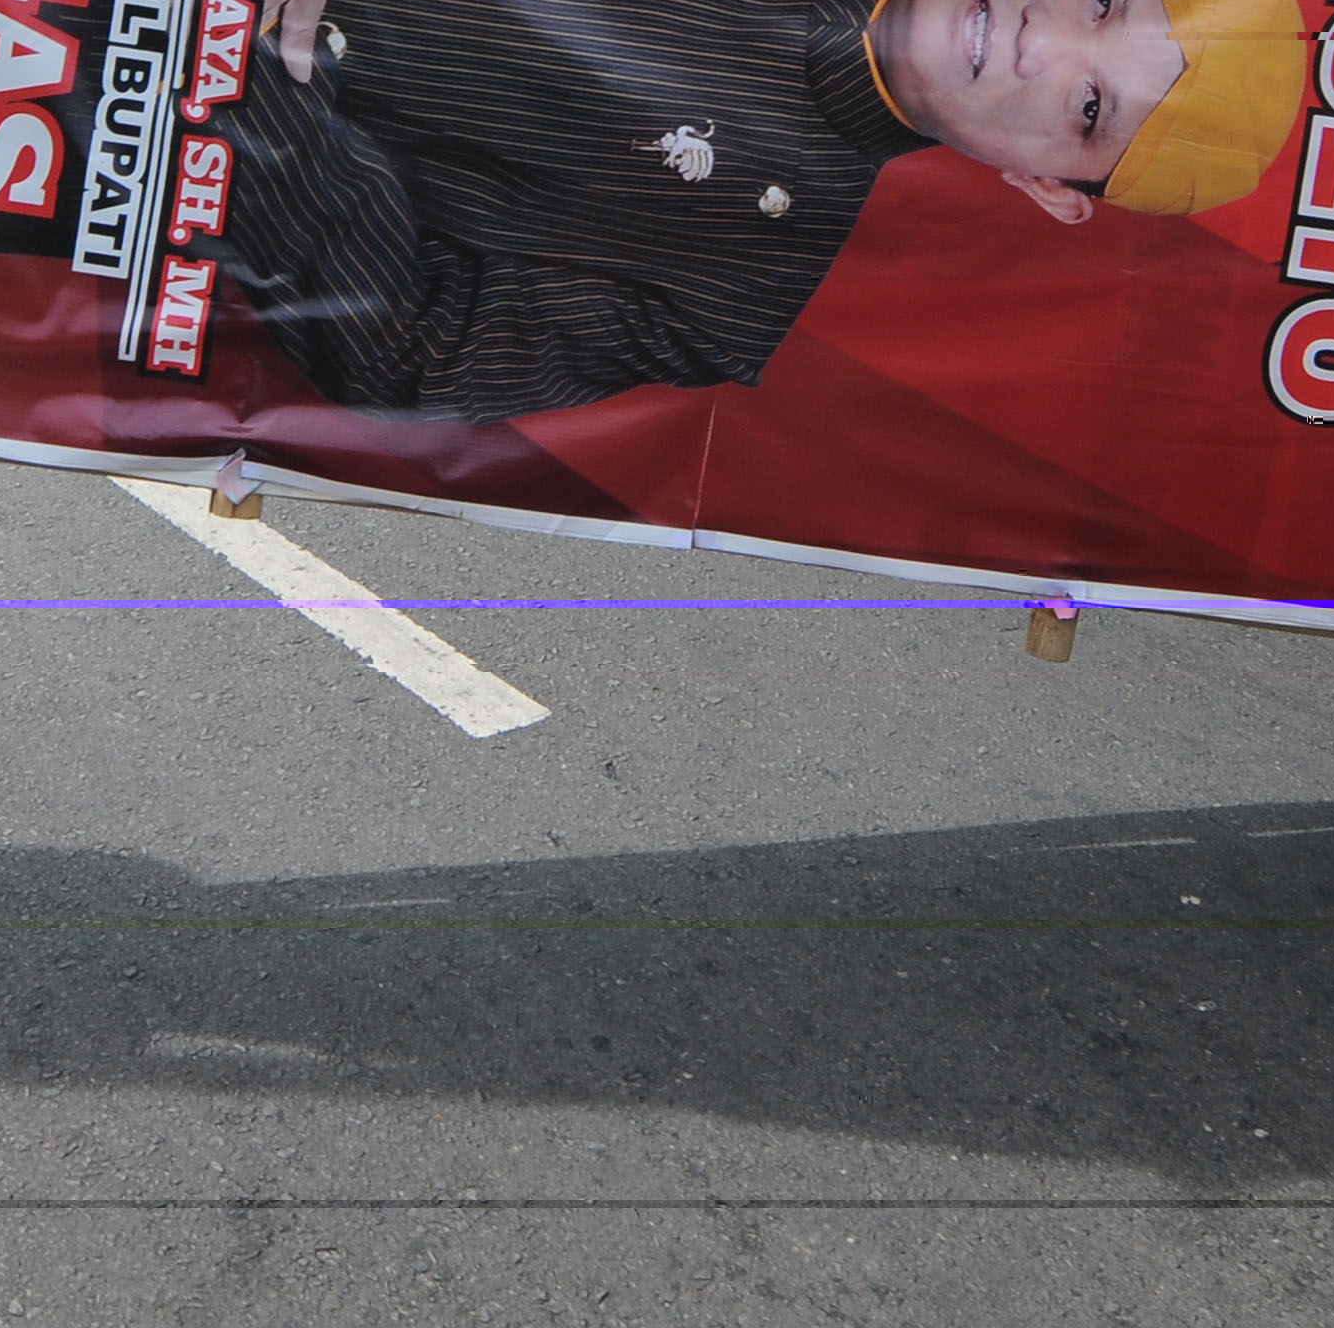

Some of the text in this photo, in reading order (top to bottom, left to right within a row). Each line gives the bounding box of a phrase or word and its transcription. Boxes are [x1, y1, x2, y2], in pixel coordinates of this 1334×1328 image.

[83, 56, 153, 269] BUPATI
[173, 139, 229, 241] SH.
[151, 260, 212, 371] MH
